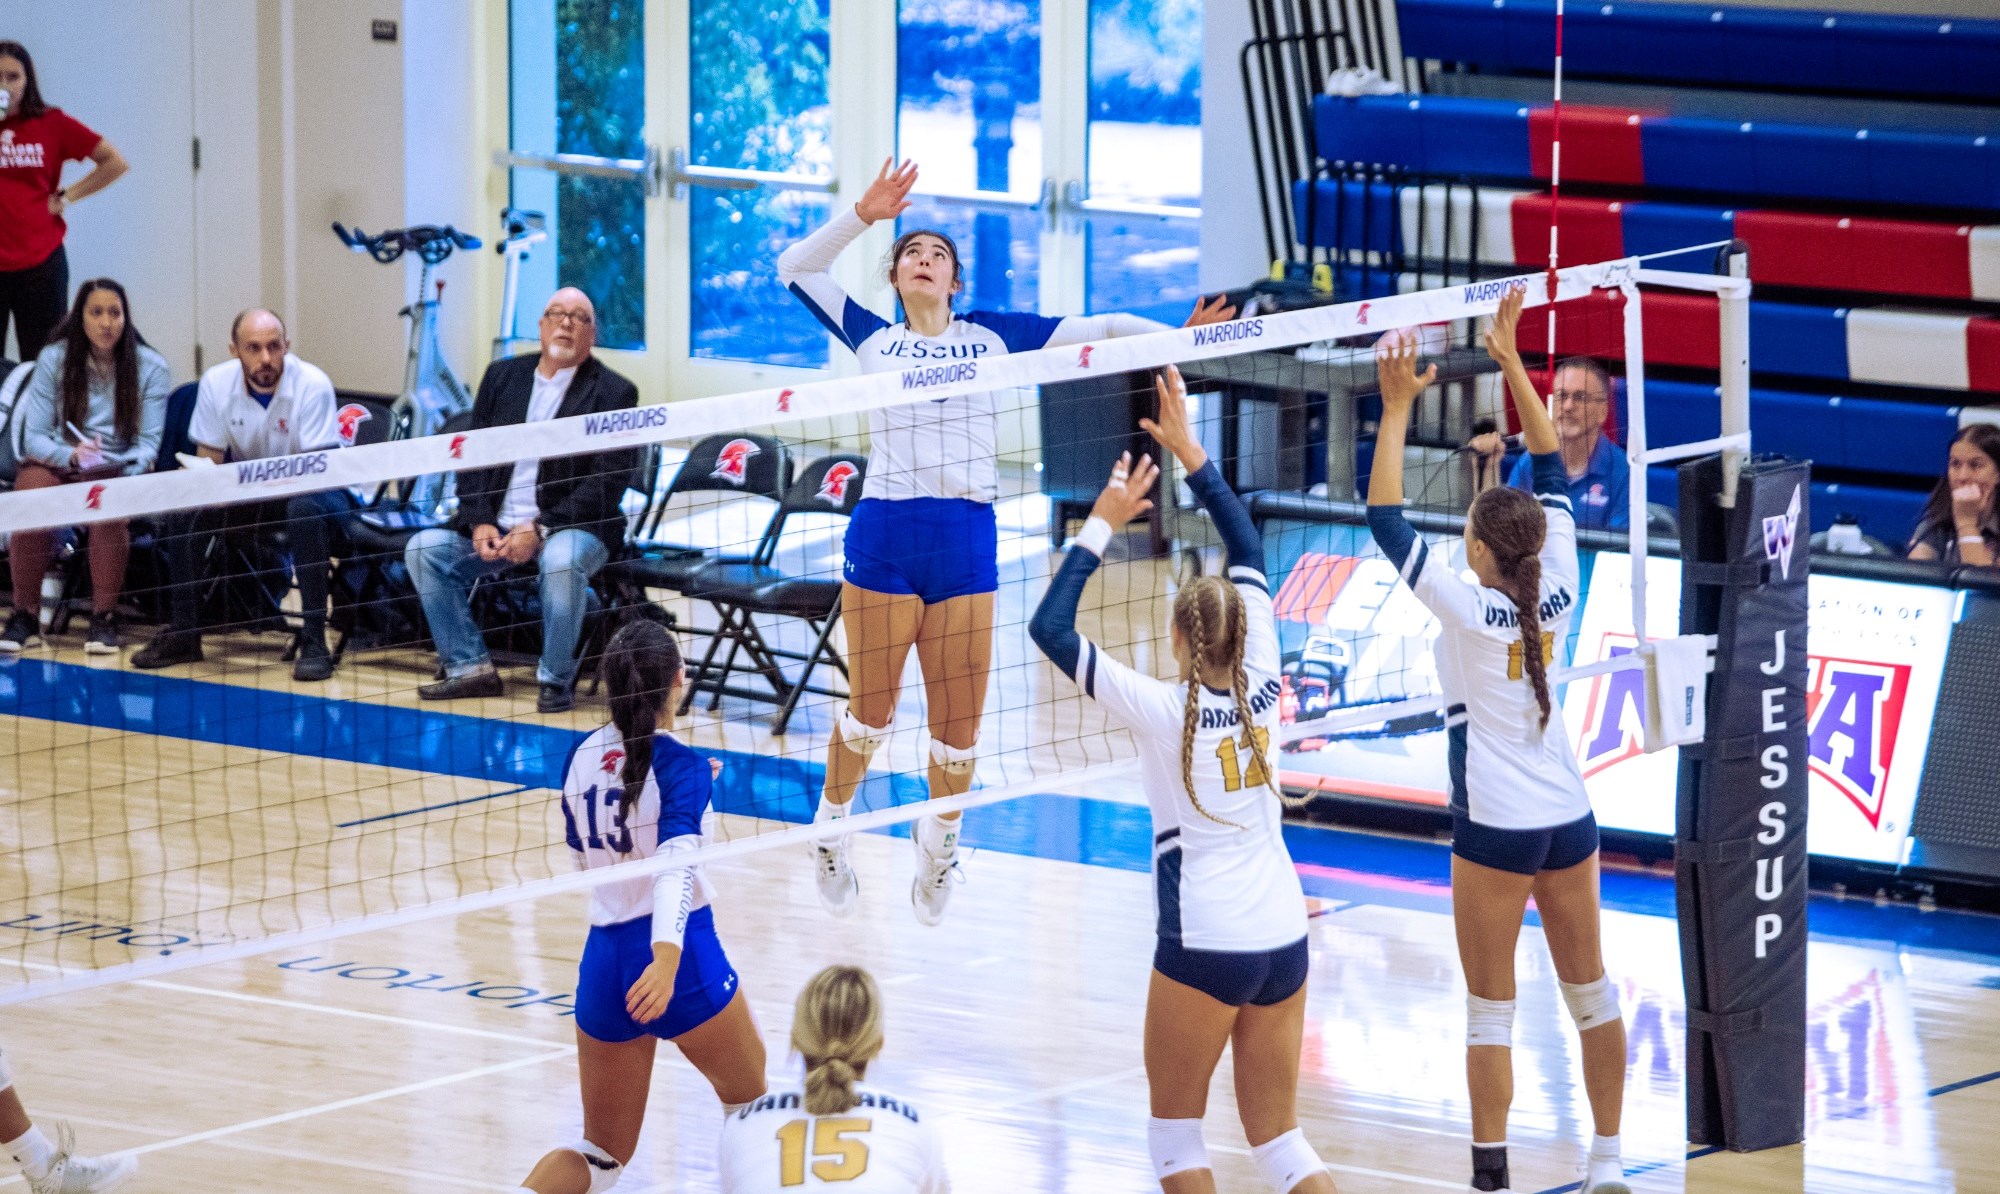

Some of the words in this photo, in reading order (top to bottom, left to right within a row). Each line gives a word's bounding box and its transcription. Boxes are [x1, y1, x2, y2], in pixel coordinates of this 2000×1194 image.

[1193, 319, 1263, 346] WARRIORS
[901, 362, 977, 390] WARRIORS
[584, 407, 667, 435] WARRIORS
[238, 453, 328, 484] WARRIORS
[1485, 586, 1572, 628] VANARD
[1755, 629, 1789, 960] JESSUP
[583, 784, 634, 853] 13
[738, 1092, 919, 1123] VANARD
[776, 1117, 872, 1188] 15
